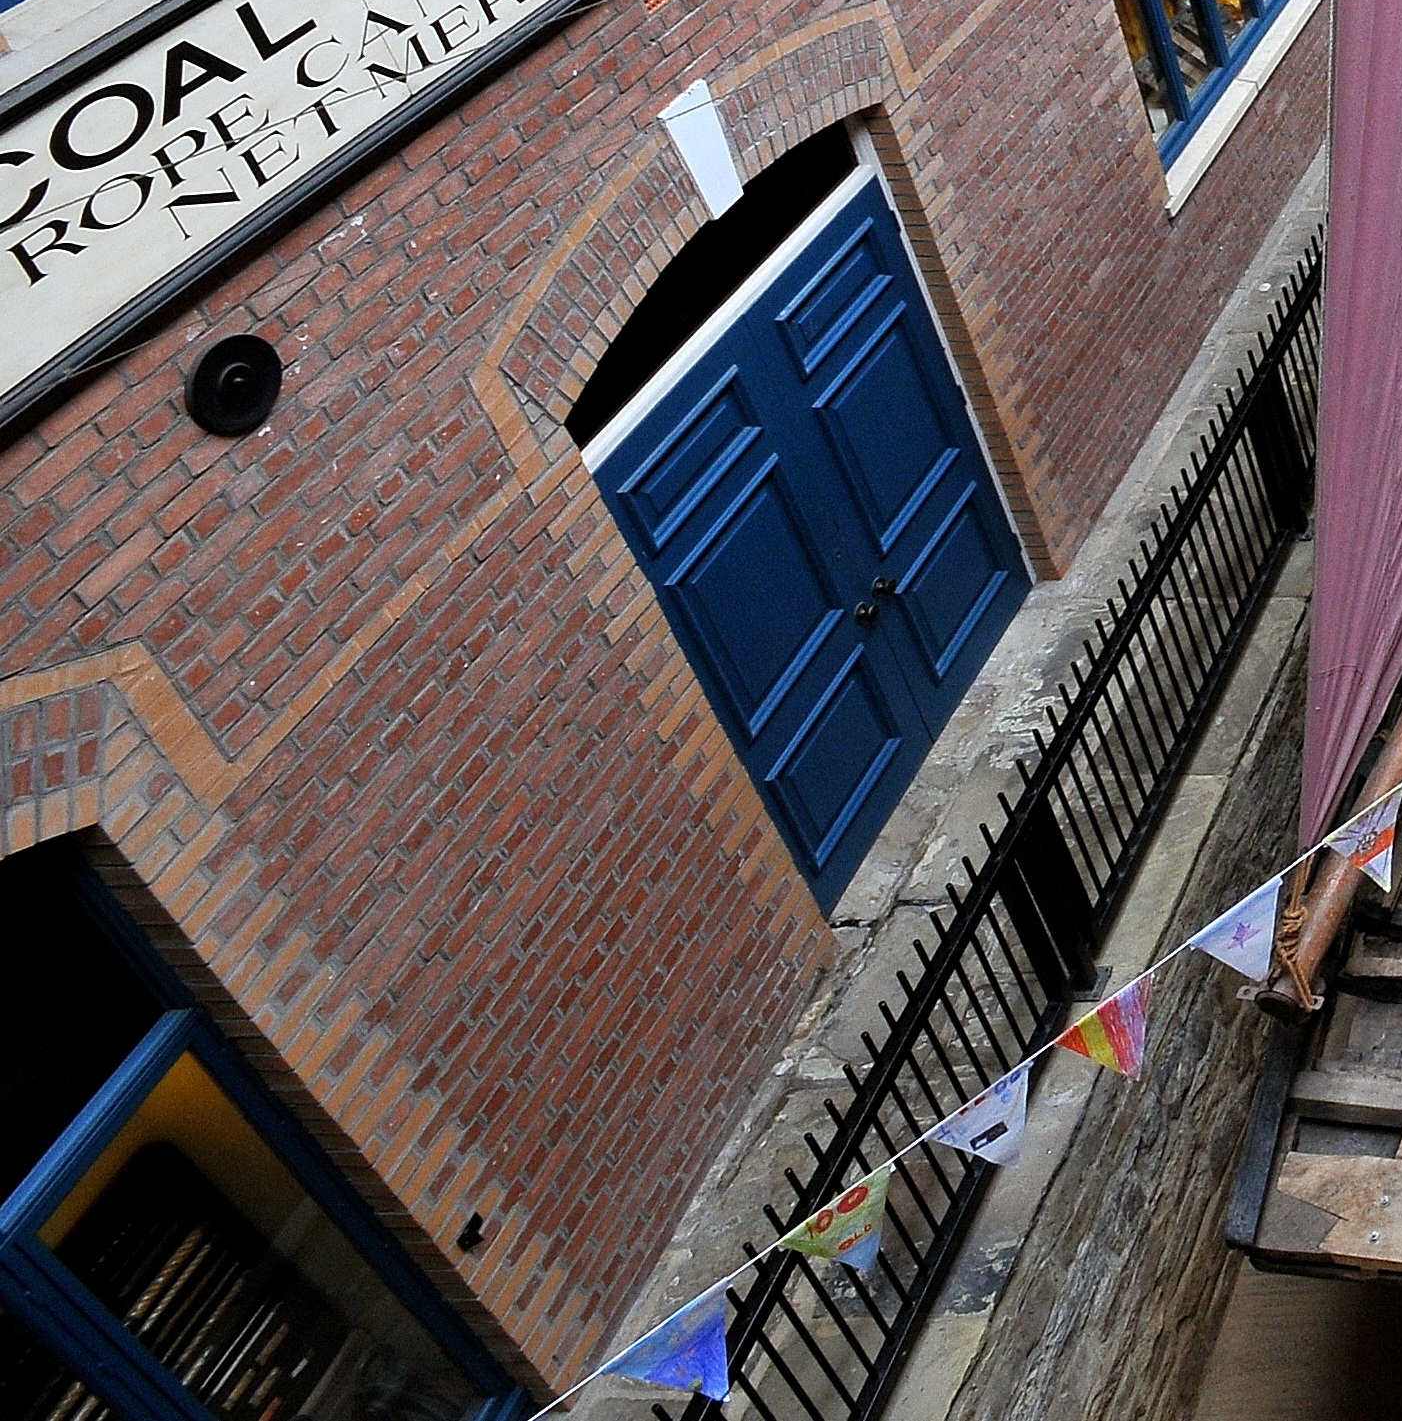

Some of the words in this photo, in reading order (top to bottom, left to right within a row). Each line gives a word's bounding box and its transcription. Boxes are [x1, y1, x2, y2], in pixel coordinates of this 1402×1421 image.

[9, 94, 270, 287] ROPE
[161, 87, 348, 240] NET
[805, 1186, 869, 1239] 100
